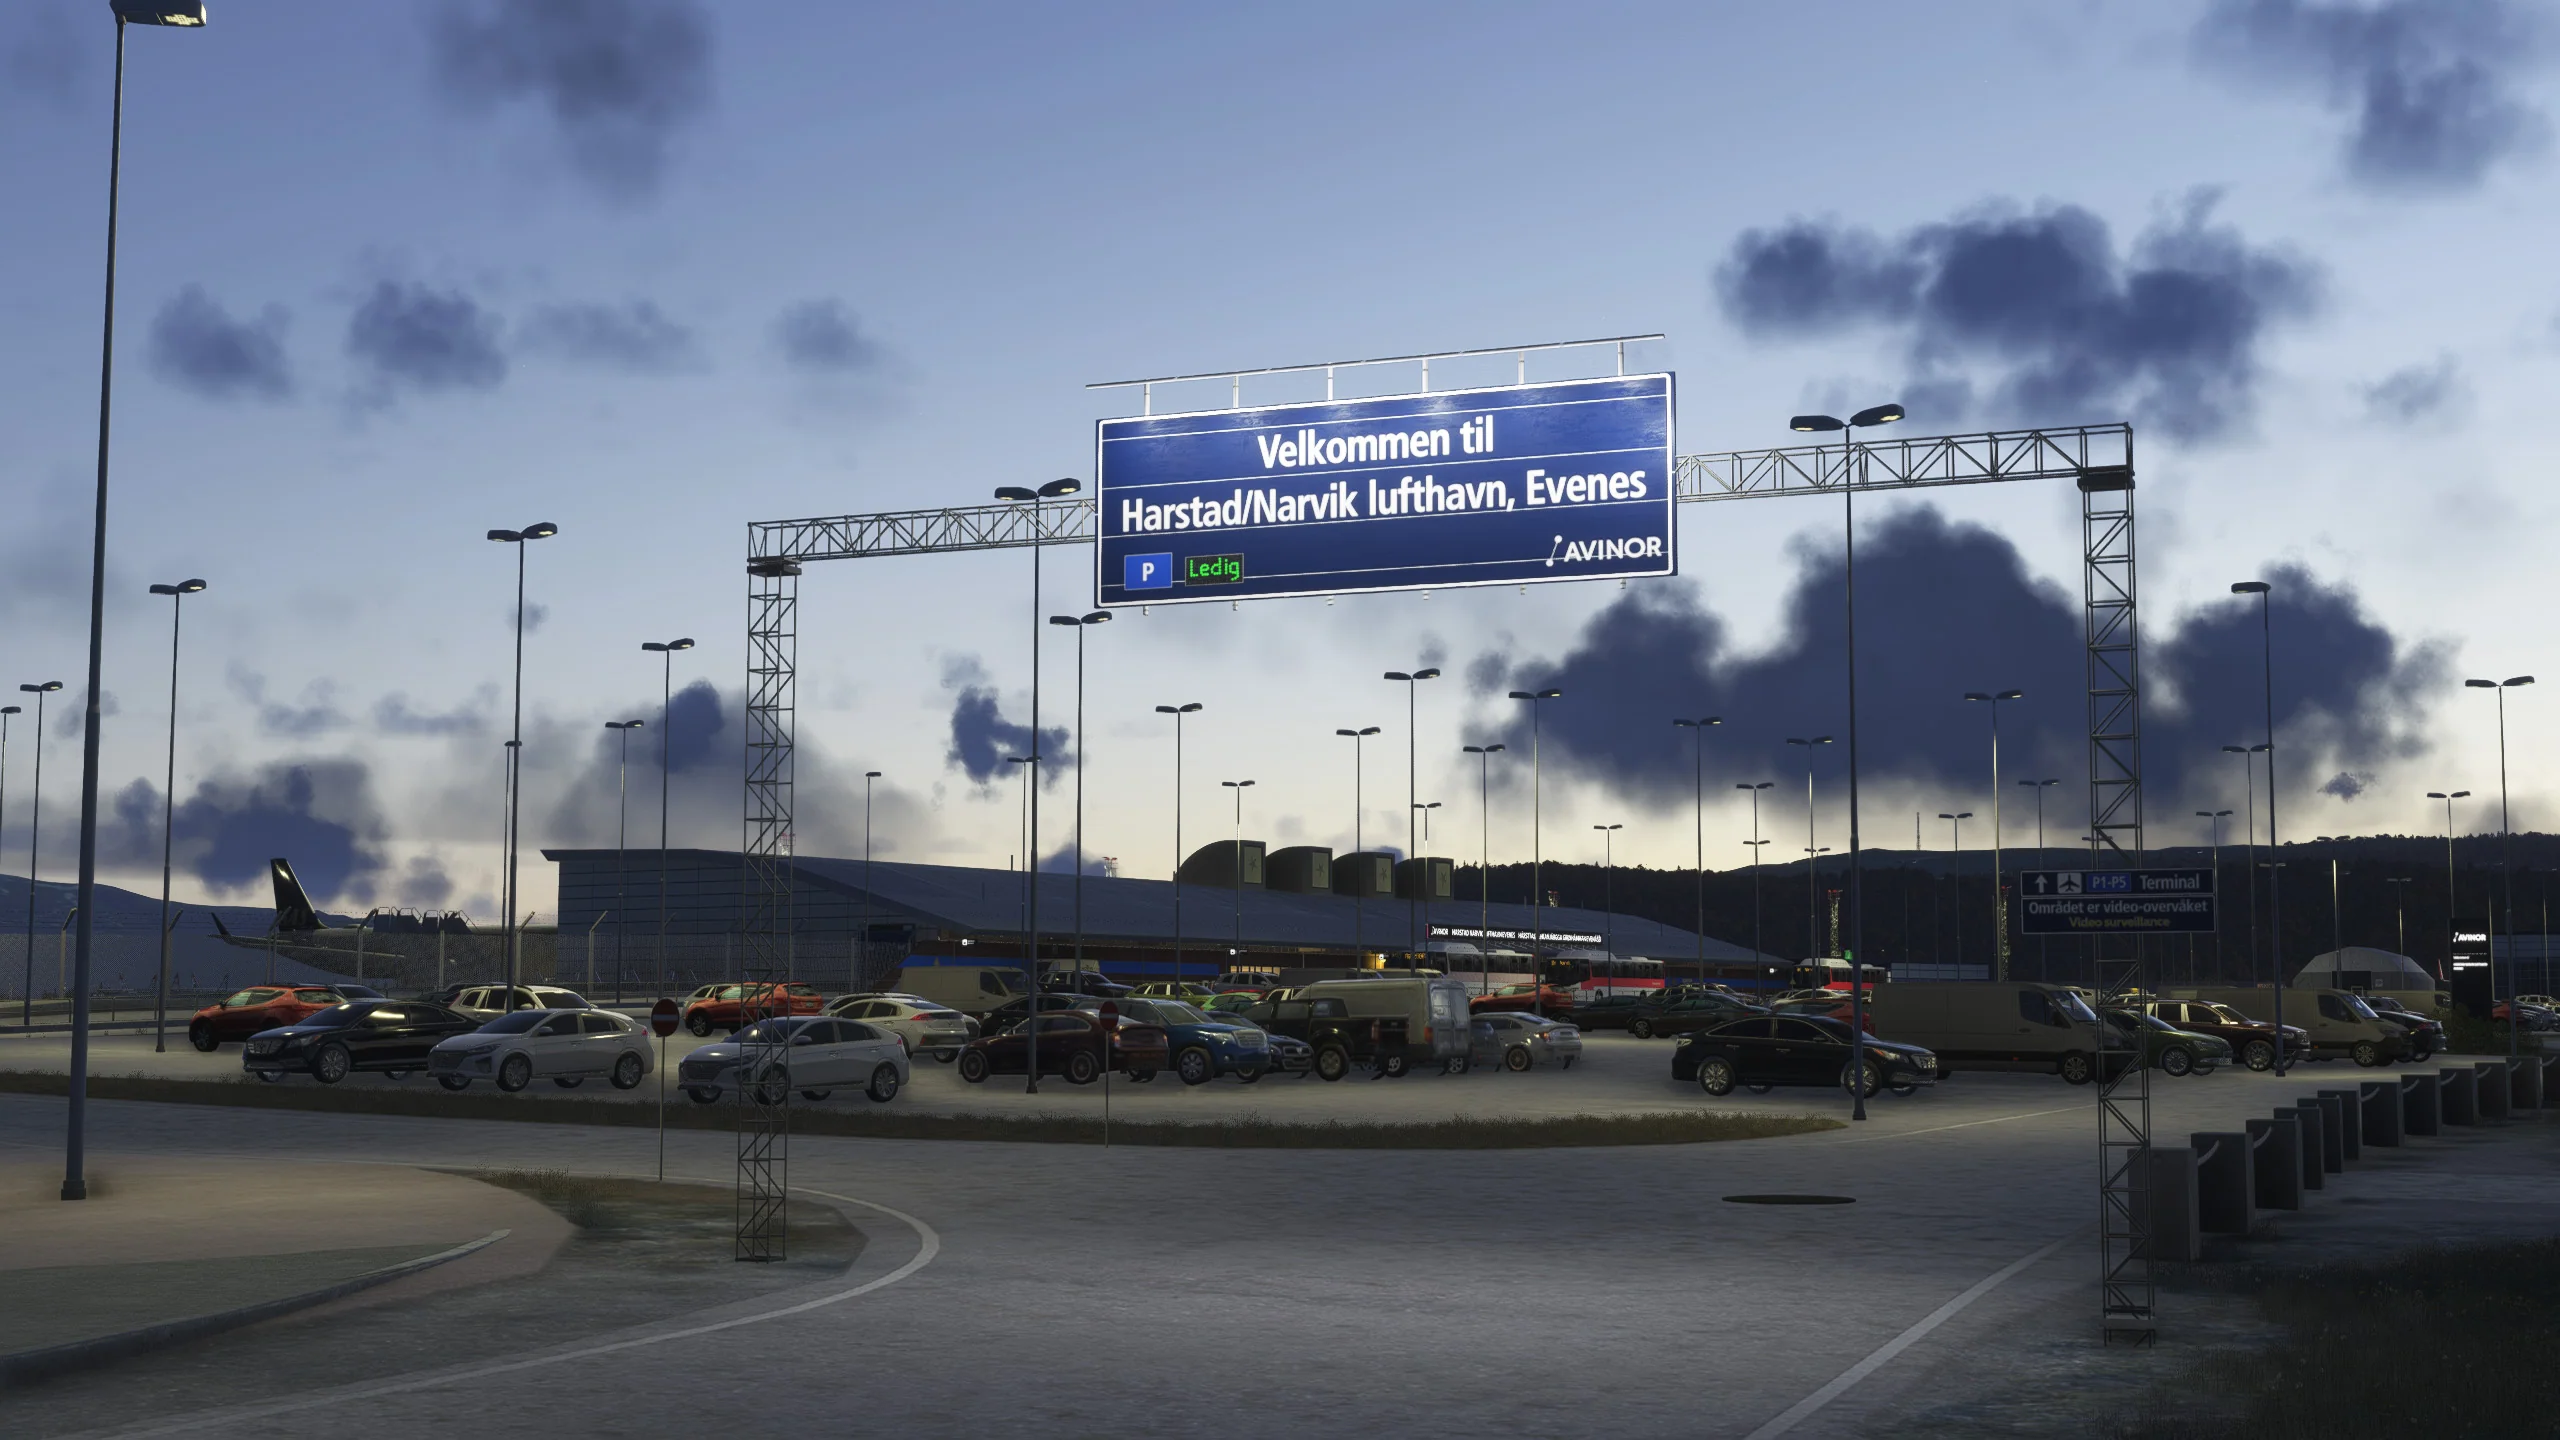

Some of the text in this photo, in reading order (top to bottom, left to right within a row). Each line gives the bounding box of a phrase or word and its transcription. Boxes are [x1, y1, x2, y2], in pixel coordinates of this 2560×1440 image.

[1257, 415, 1494, 469] Velkommen til
[1122, 470, 1647, 533] Harstad/Narvik lufthavn, Evenes
[1564, 536, 1662, 563] AVINOR
[1142, 562, 1155, 582] P
[1189, 556, 1240, 582] Ledig
[2092, 874, 2200, 890] P1-P5 Terminal
[2029, 900, 2208, 914] Området er video-overvåket
[2069, 916, 2171, 928] Video surveillance
[2458, 933, 2487, 942] AVINOR
